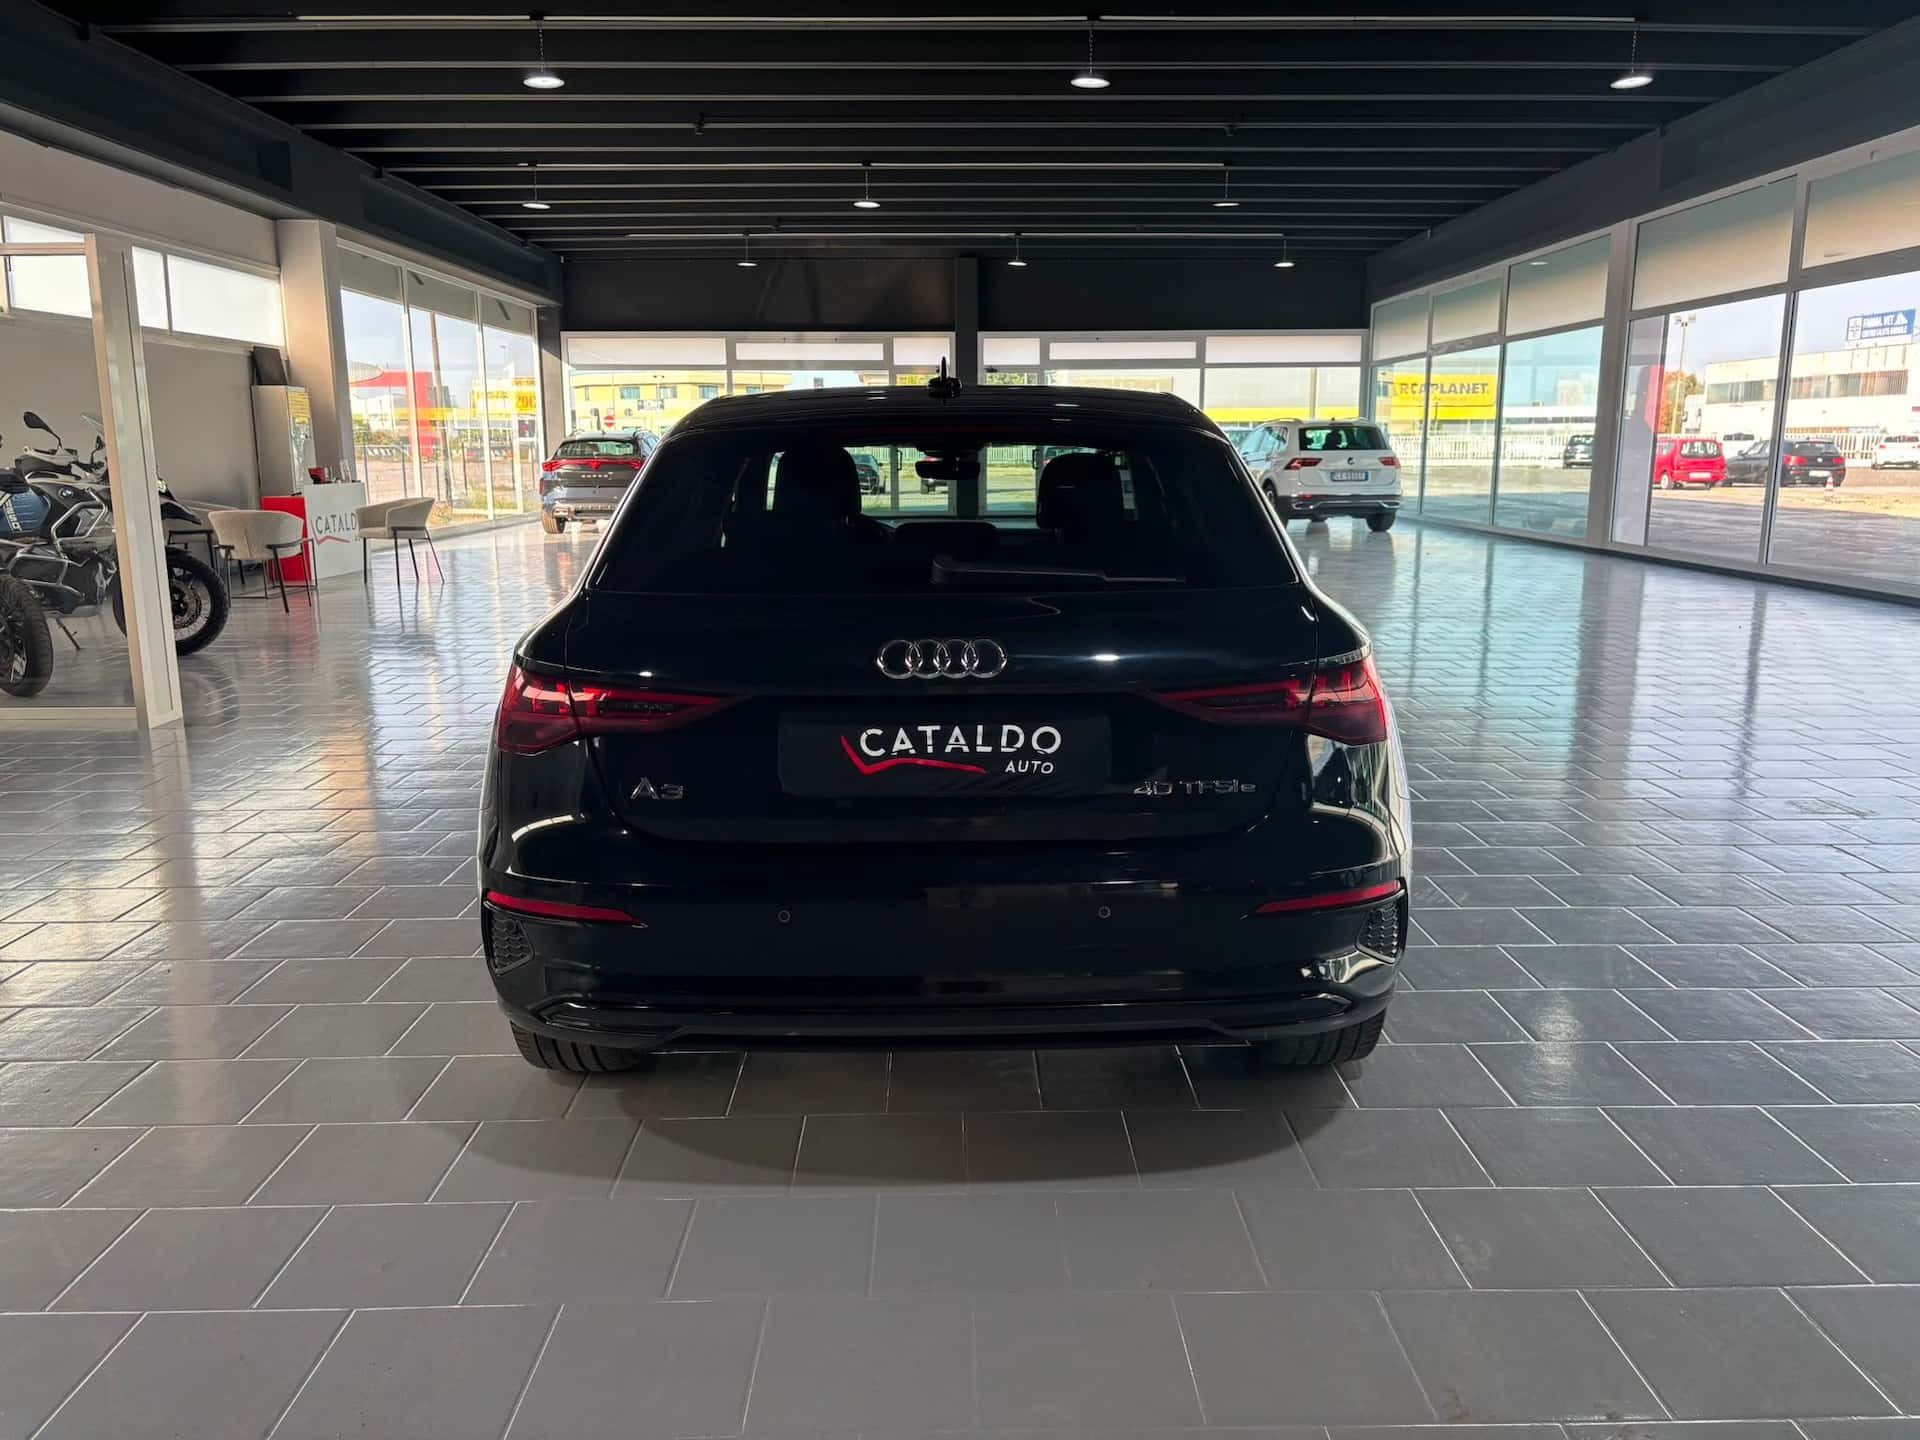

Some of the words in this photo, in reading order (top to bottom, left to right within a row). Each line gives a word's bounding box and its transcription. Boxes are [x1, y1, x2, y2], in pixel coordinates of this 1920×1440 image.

[315, 512, 358, 534] CATALD
[859, 724, 1062, 757] CATALDO
[1004, 760, 1055, 774] AUTO
[630, 776, 684, 800] A3
[1134, 781, 1173, 796] 40
